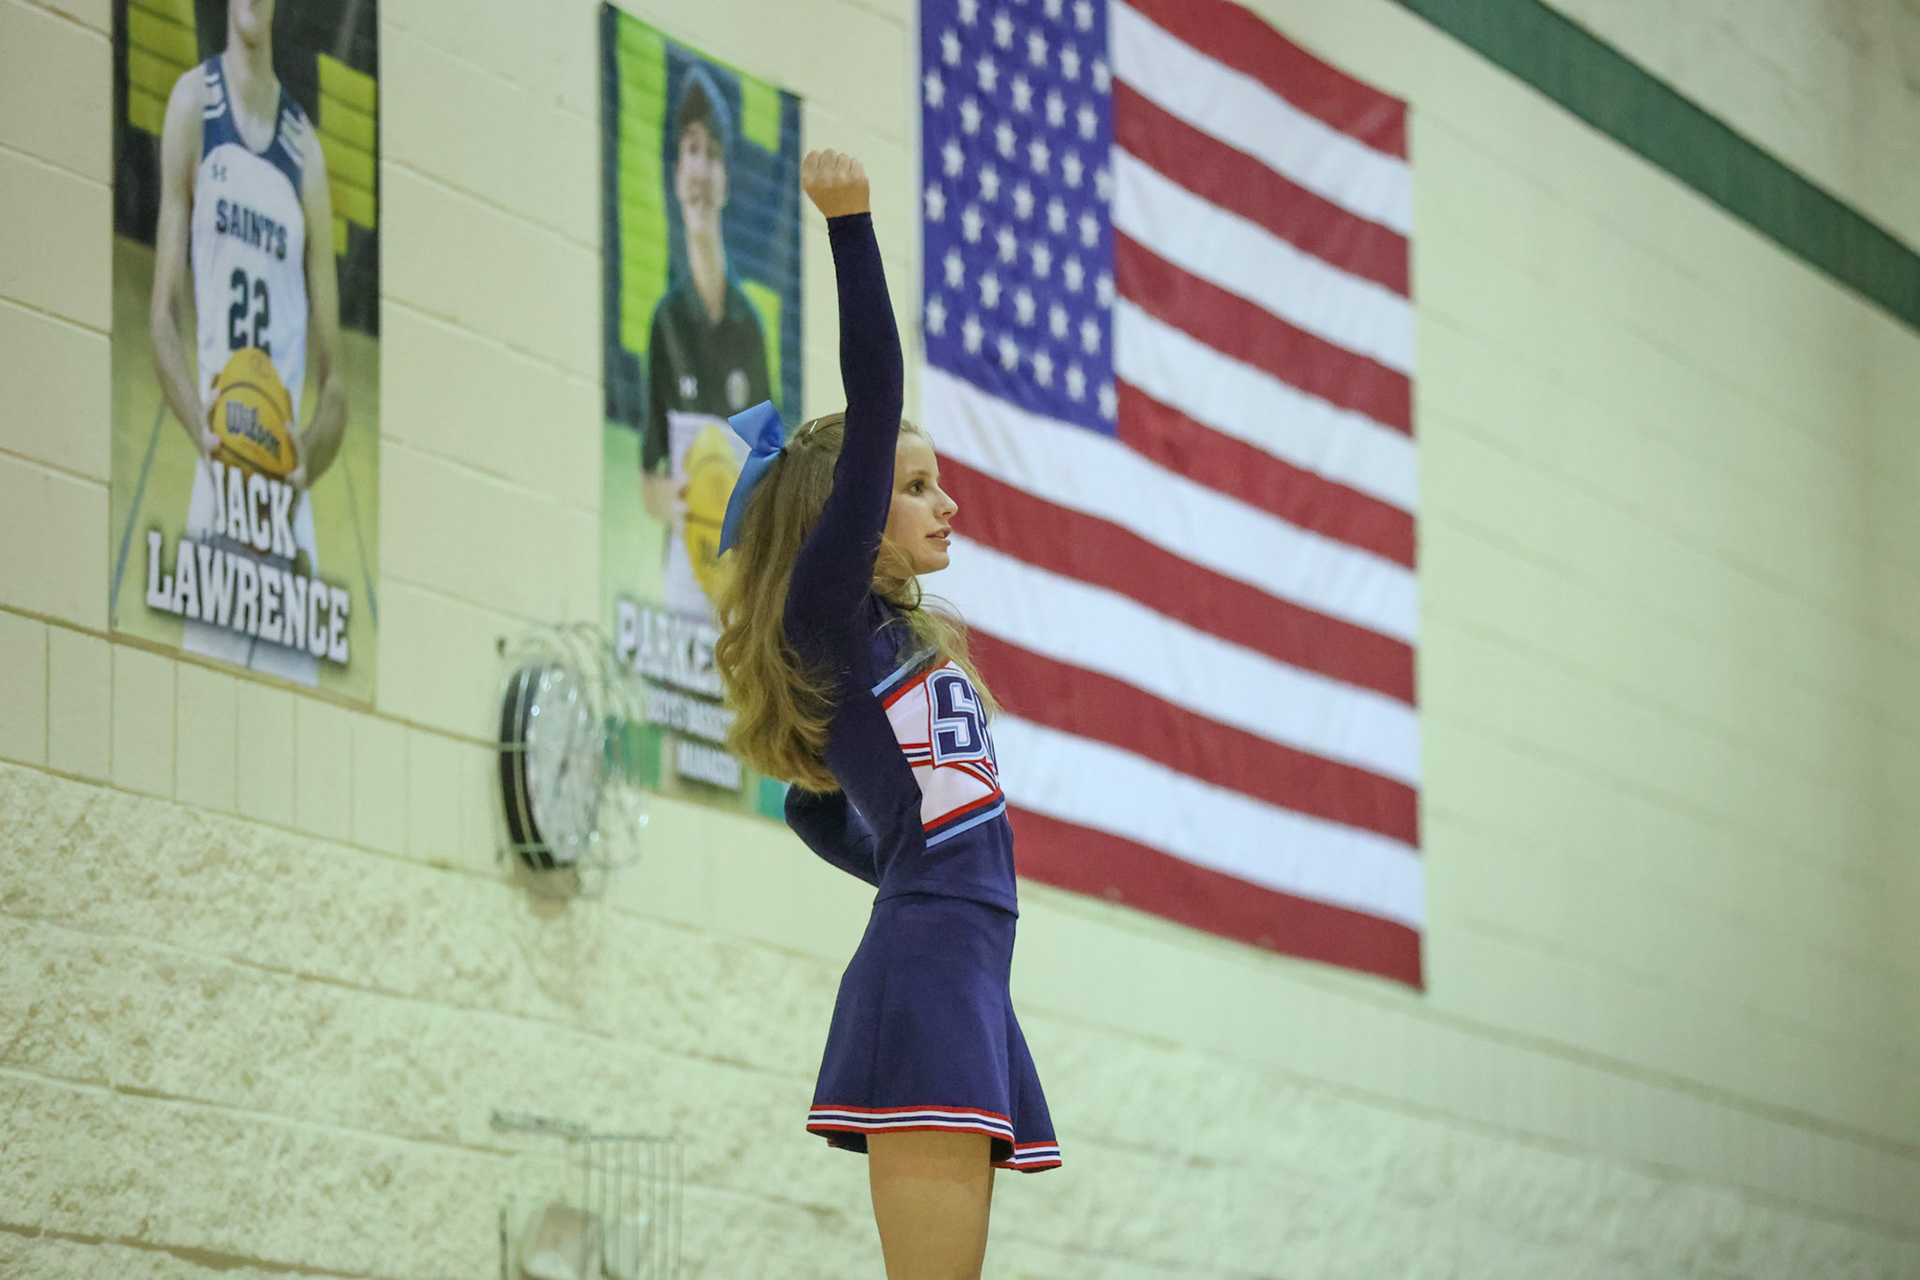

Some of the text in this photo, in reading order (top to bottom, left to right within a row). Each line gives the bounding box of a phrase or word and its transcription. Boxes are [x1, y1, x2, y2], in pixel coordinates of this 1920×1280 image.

[216, 199, 288, 262] SAINTS
[229, 266, 272, 356] 22
[213, 460, 296, 560] JACK
[147, 530, 349, 664] LAWRENCE
